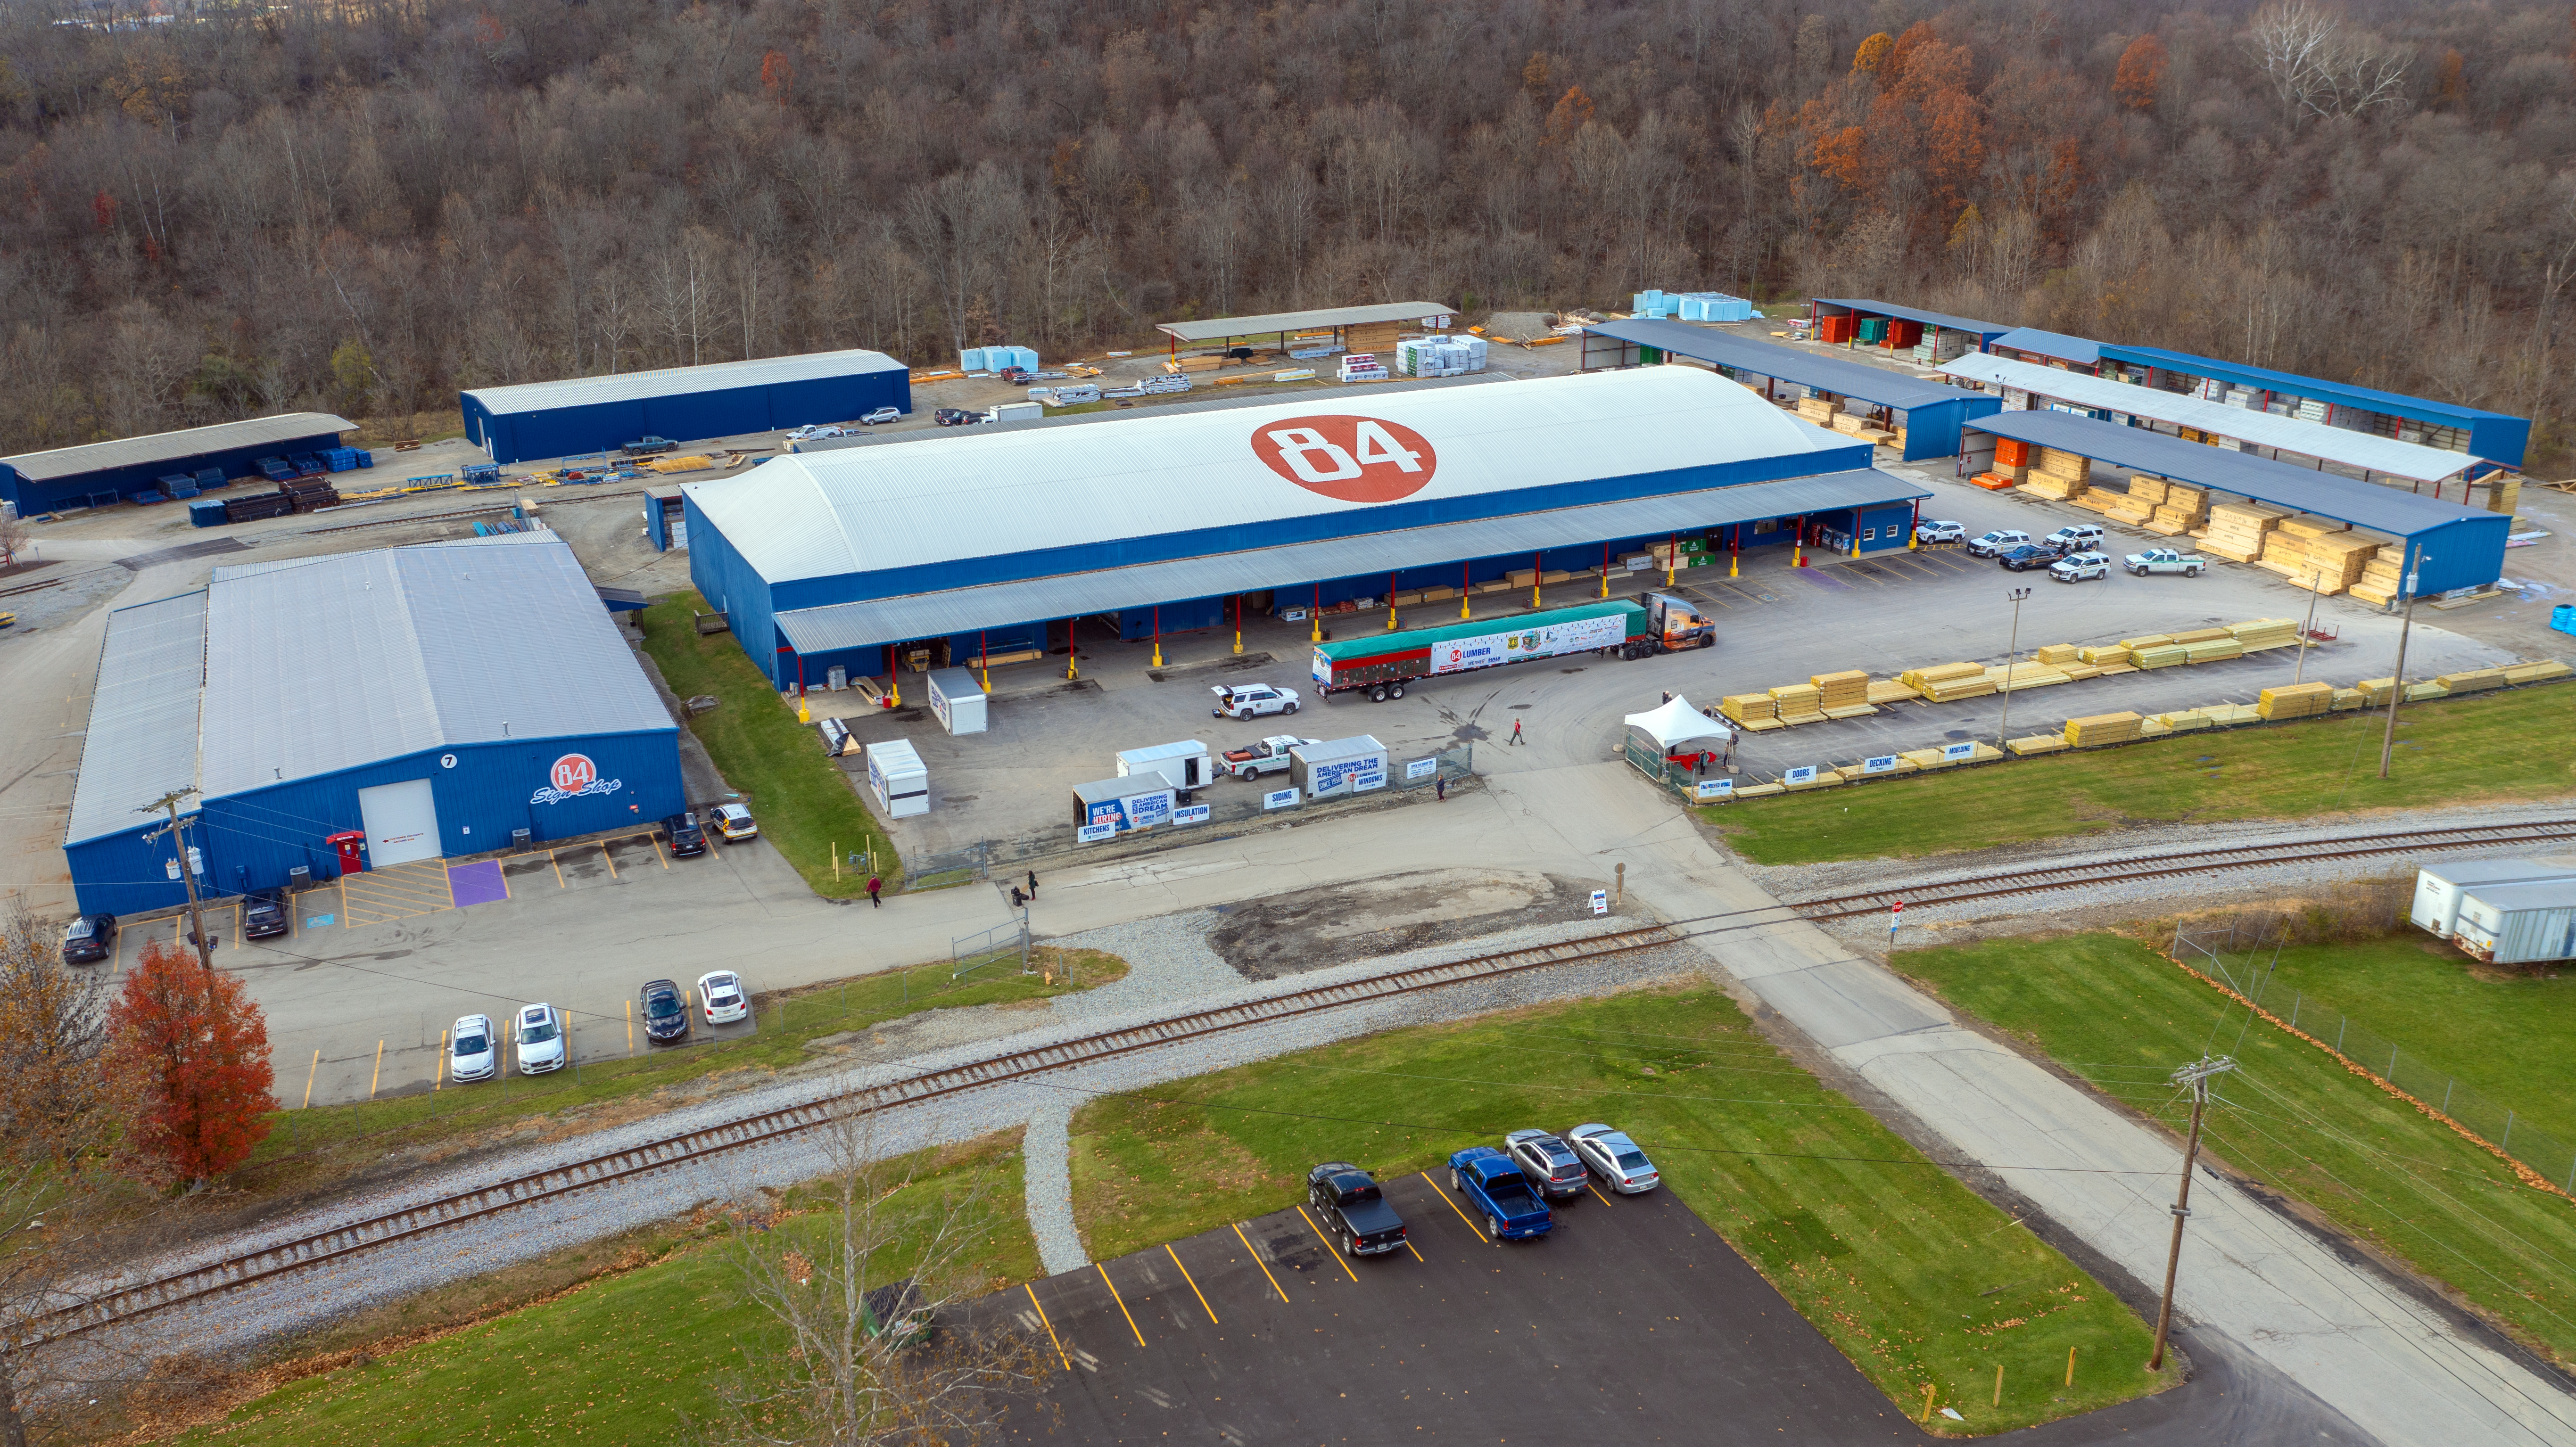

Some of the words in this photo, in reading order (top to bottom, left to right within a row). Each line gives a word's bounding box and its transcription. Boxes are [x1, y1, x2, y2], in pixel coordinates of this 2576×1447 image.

[1267, 420, 1423, 483] 84
[1452, 652, 1460, 661] 84
[1463, 647, 1491, 658] LUMBER
[1949, 745, 1970, 754] MOULDING
[445, 756, 453, 766] 7
[1869, 757, 1891, 767] DECKING
[1317, 761, 1362, 773] DELIVERING
[1317, 768, 1352, 778] AMERICAN
[1354, 763, 1378, 772] DREAM
[558, 762, 589, 786] 84
[1792, 768, 1809, 778] DOORS
[1331, 776, 1341, 785] 1956
[1359, 774, 1383, 785] WINDOWS
[531, 788, 572, 804] Sign
[579, 779, 621, 795] Shop
[1272, 791, 1292, 802] SIDING
[1132, 794, 1167, 804] DELIVERING
[1139, 798, 1167, 807] AMERICAN
[1092, 804, 1115, 816] WE'RE
[1139, 803, 1167, 813] DREAM
[1175, 806, 1208, 818] INSULATION
[1093, 812, 1121, 824] HIRING
[1084, 824, 1109, 835] KITCHENS
